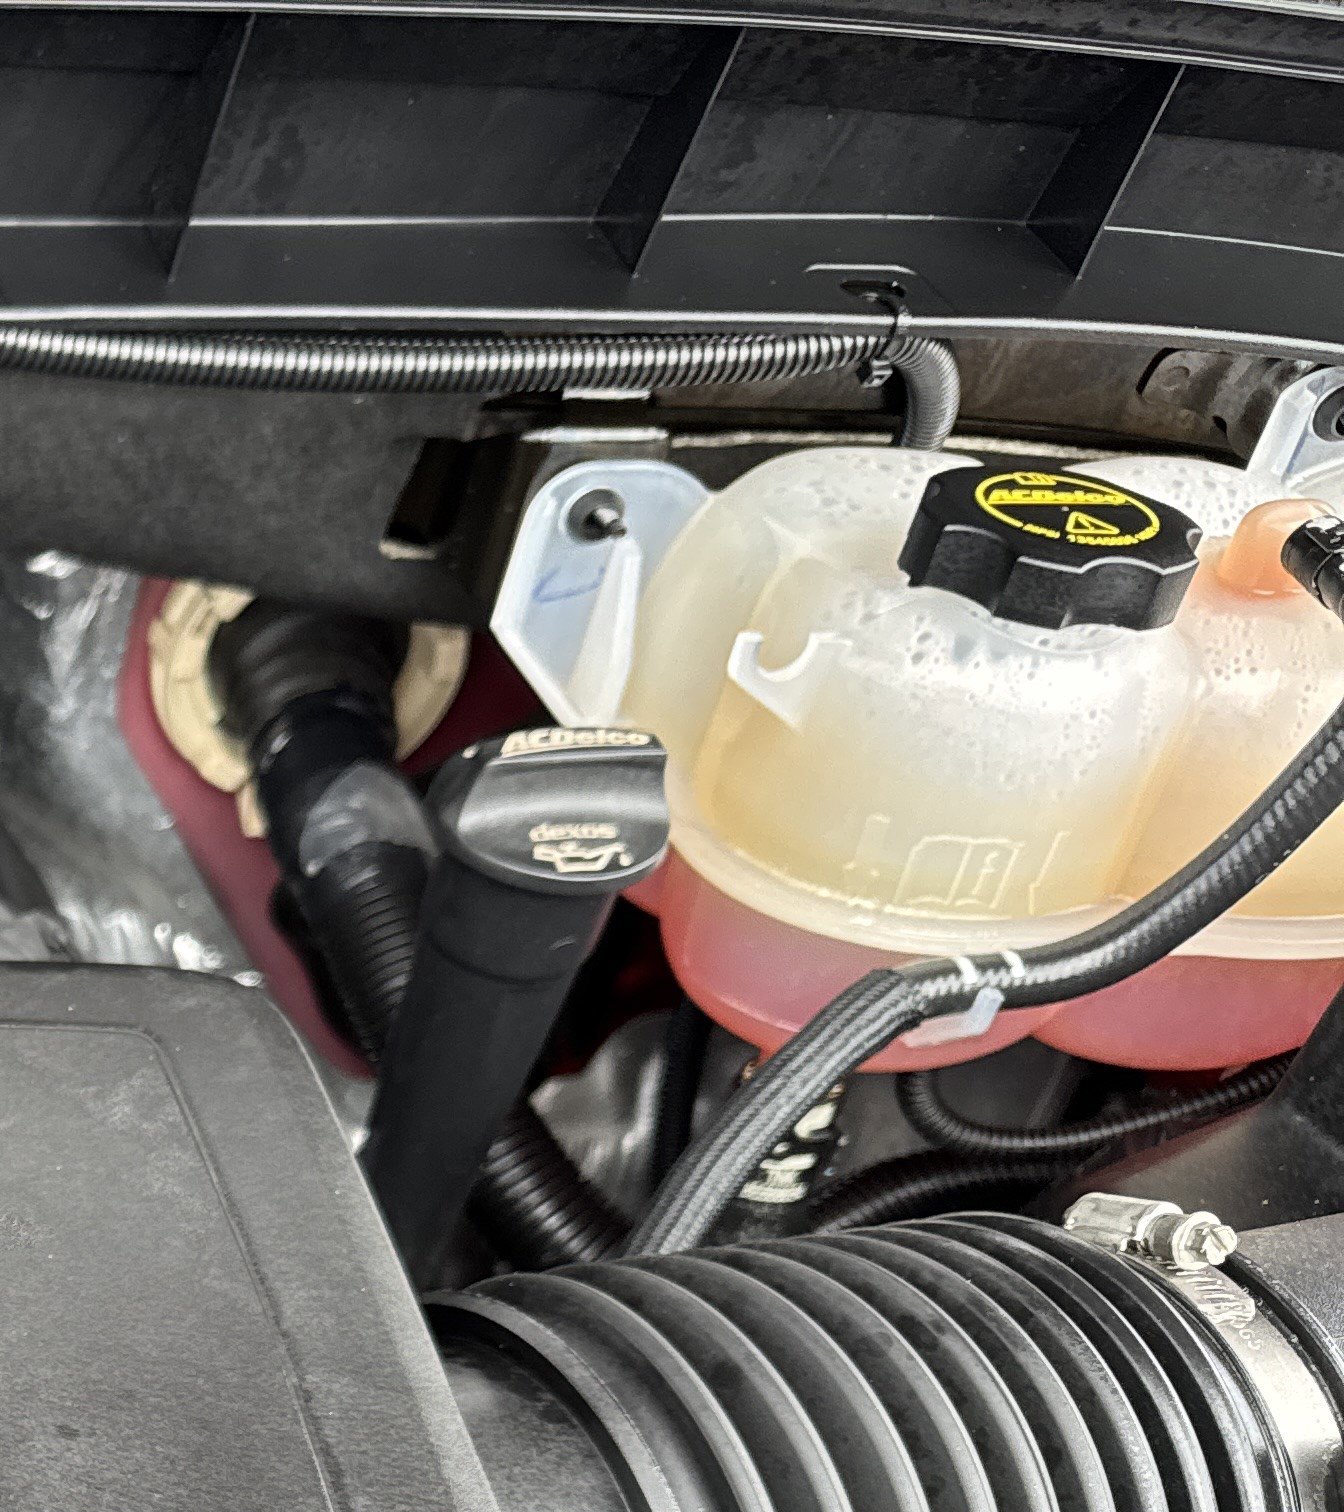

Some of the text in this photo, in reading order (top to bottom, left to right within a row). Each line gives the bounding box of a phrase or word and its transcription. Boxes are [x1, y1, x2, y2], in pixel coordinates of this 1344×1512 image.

[988, 489, 1127, 504] ACDelco
[500, 727, 650, 757] ACDelco
[528, 822, 619, 843] dexos
